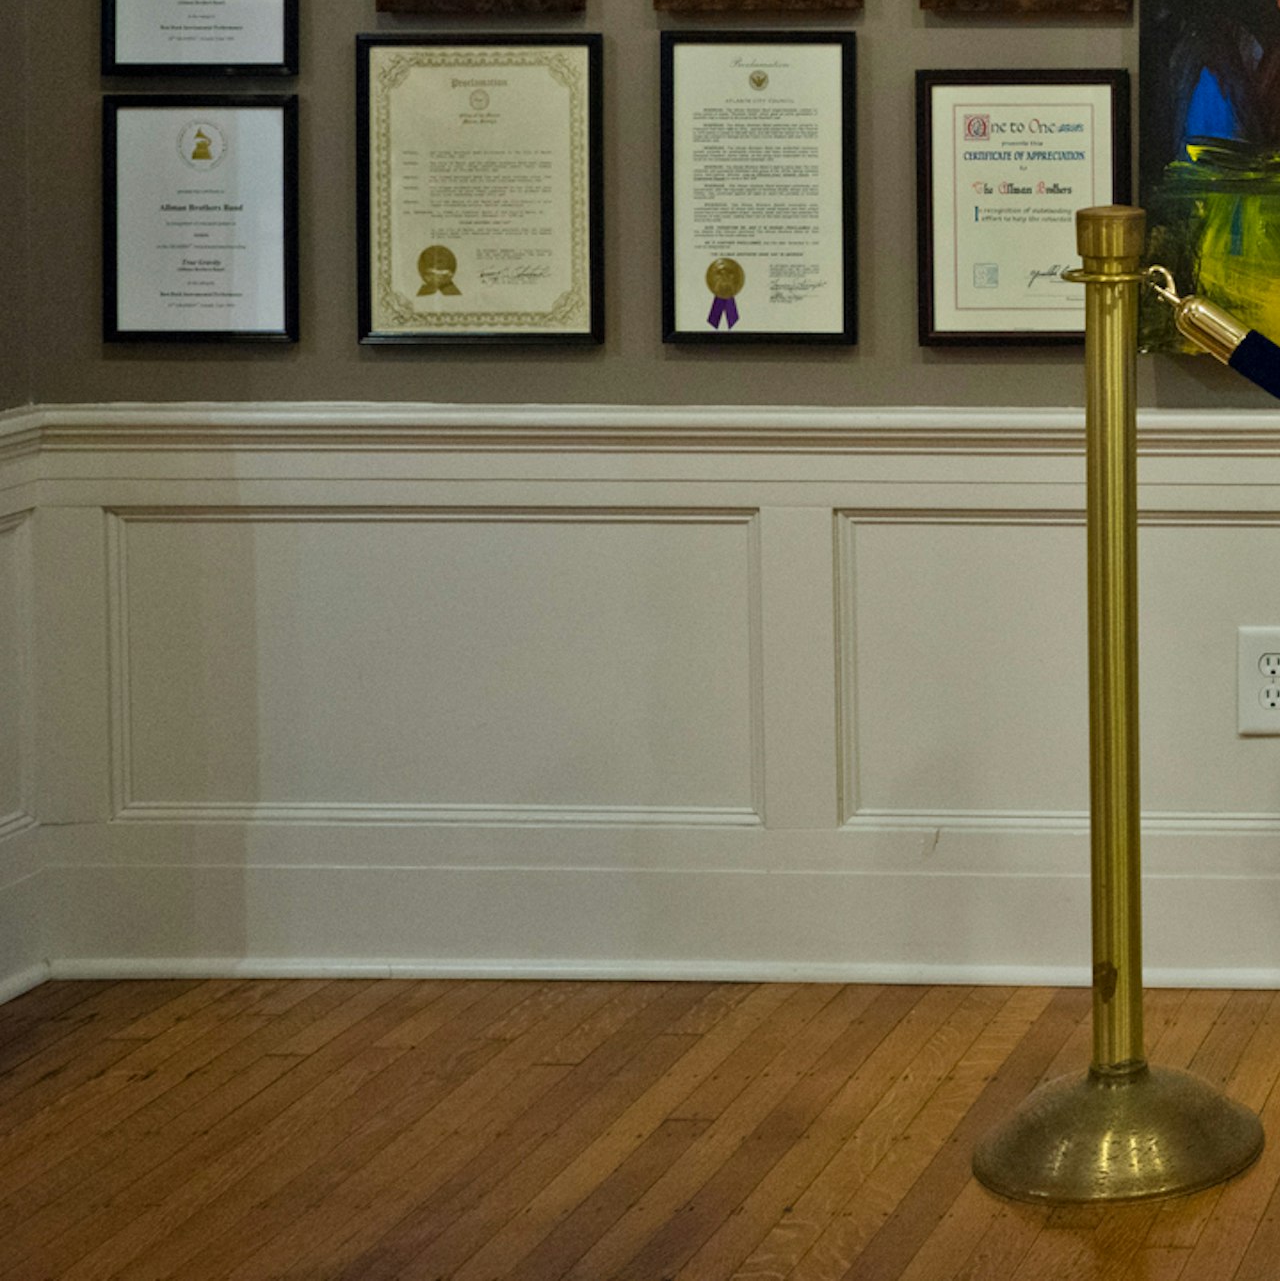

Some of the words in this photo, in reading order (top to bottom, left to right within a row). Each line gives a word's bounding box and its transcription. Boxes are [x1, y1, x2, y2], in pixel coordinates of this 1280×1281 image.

[1009, 122, 1026, 134] to
[1028, 117, 1056, 134] One
[963, 150, 1012, 161] CERTIFICATE
[1026, 149, 1086, 161] APPRECIATION
